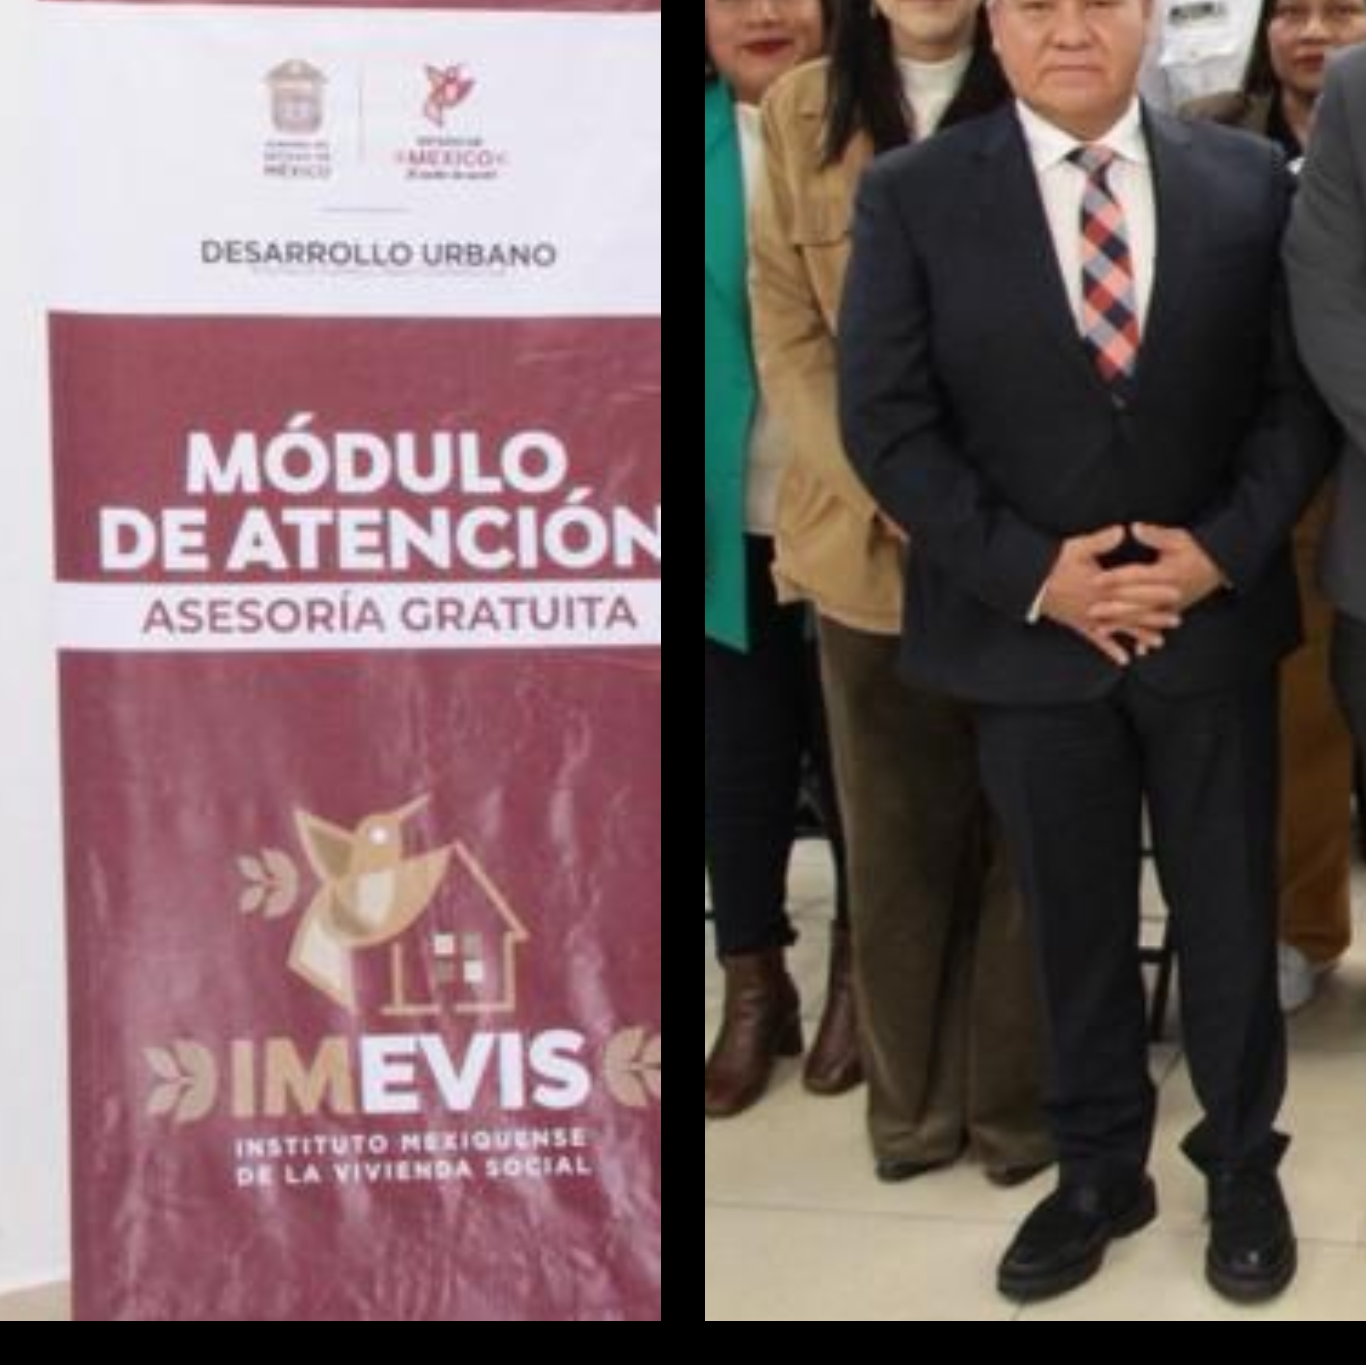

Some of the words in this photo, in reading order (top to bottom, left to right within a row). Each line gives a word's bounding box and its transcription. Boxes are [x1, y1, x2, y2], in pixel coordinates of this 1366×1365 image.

[201, 240, 412, 267] DESARROLLO
[423, 243, 557, 268] URBANO
[187, 413, 567, 494] MÓDULO
[99, 508, 209, 571] DE
[226, 487, 661, 570] ATENCIÓN
[143, 591, 385, 635] ASESORÍA
[401, 595, 637, 632] GRATUITA
[231, 1028, 592, 1117] IMEVIS
[237, 1135, 387, 1157] INSTITUTO
[402, 1129, 586, 1153] MEXIQUENSE
[237, 1166, 274, 1187] DE
[285, 1164, 321, 1183] LA
[333, 1160, 472, 1182] VIVIENDA
[486, 1155, 593, 1179] SOCIAL
